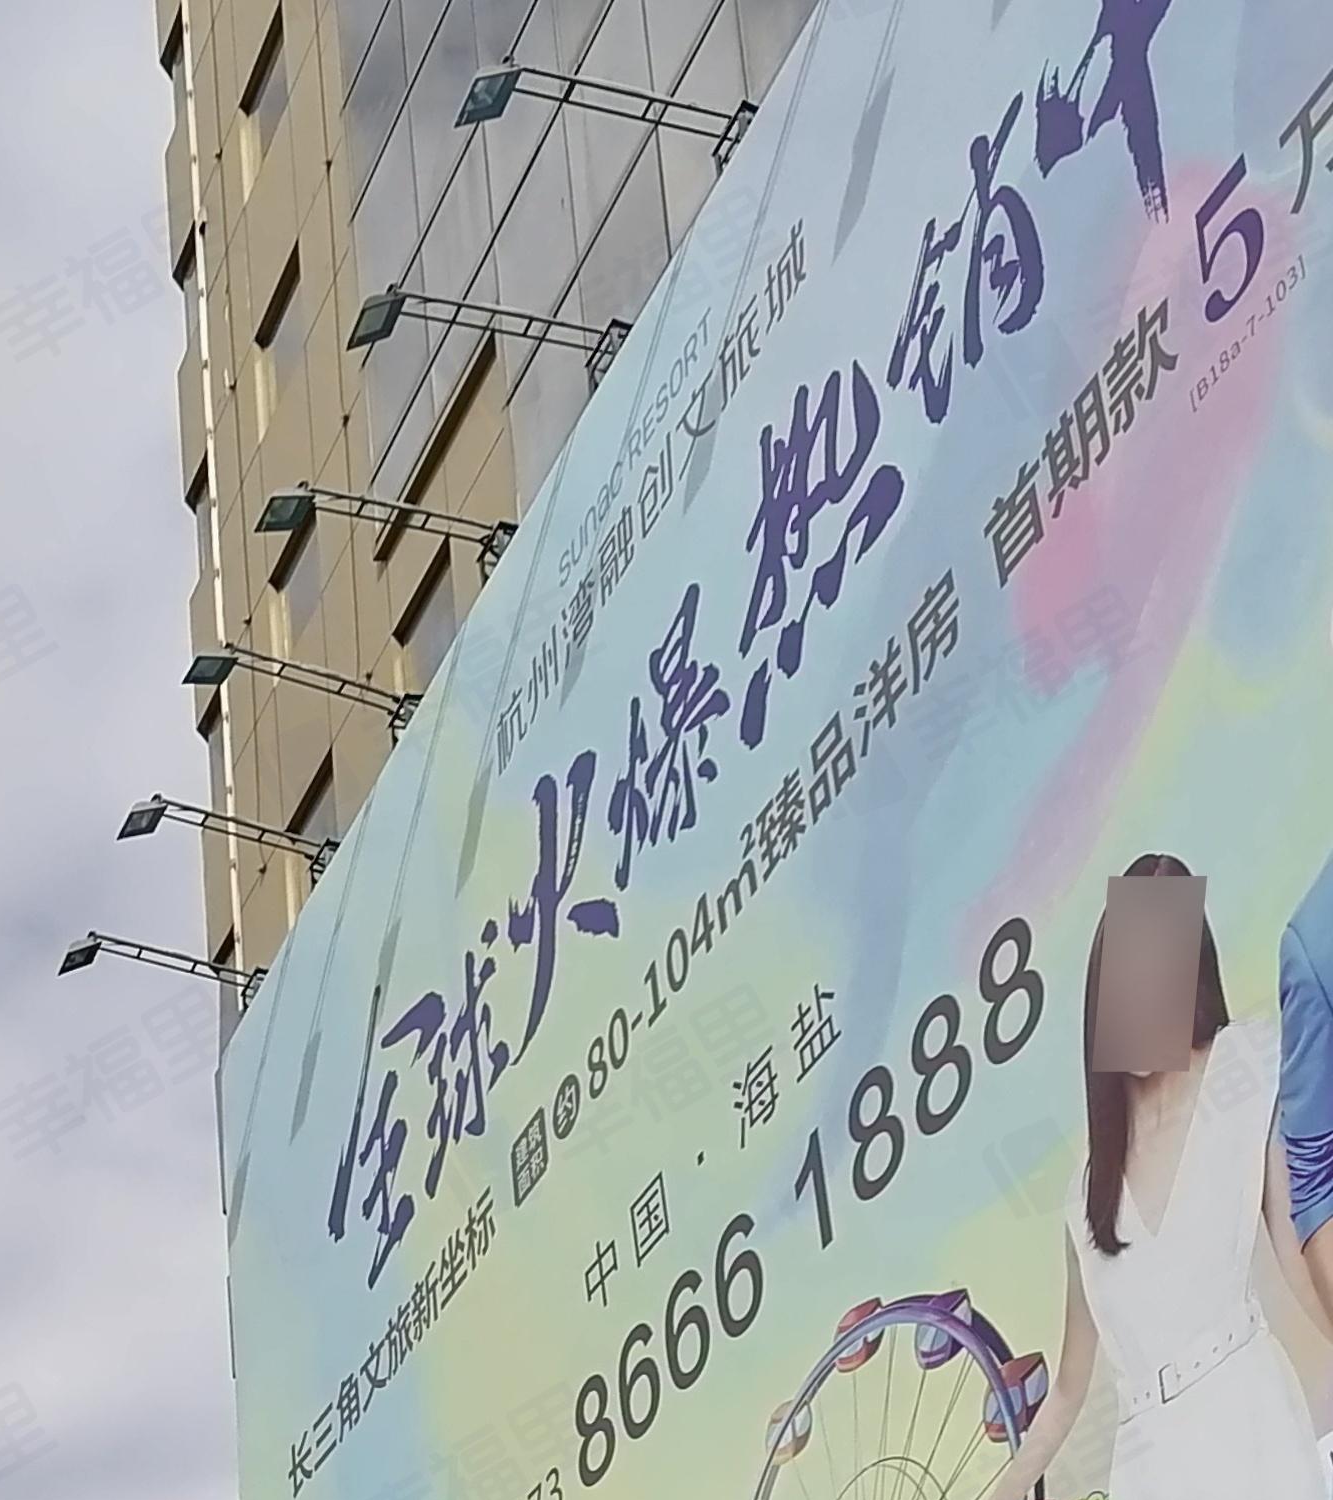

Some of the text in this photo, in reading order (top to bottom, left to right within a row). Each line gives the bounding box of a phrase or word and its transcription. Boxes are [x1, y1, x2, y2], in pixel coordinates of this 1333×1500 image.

[497, 218, 809, 777] 杭州湾融创文旅城
[629, 306, 713, 471] RESORT
[288, 1185, 496, 1498] 长三角文旅新坐标
[574, 1212, 765, 1488] 8666
[791, 916, 1048, 1250] 1888
